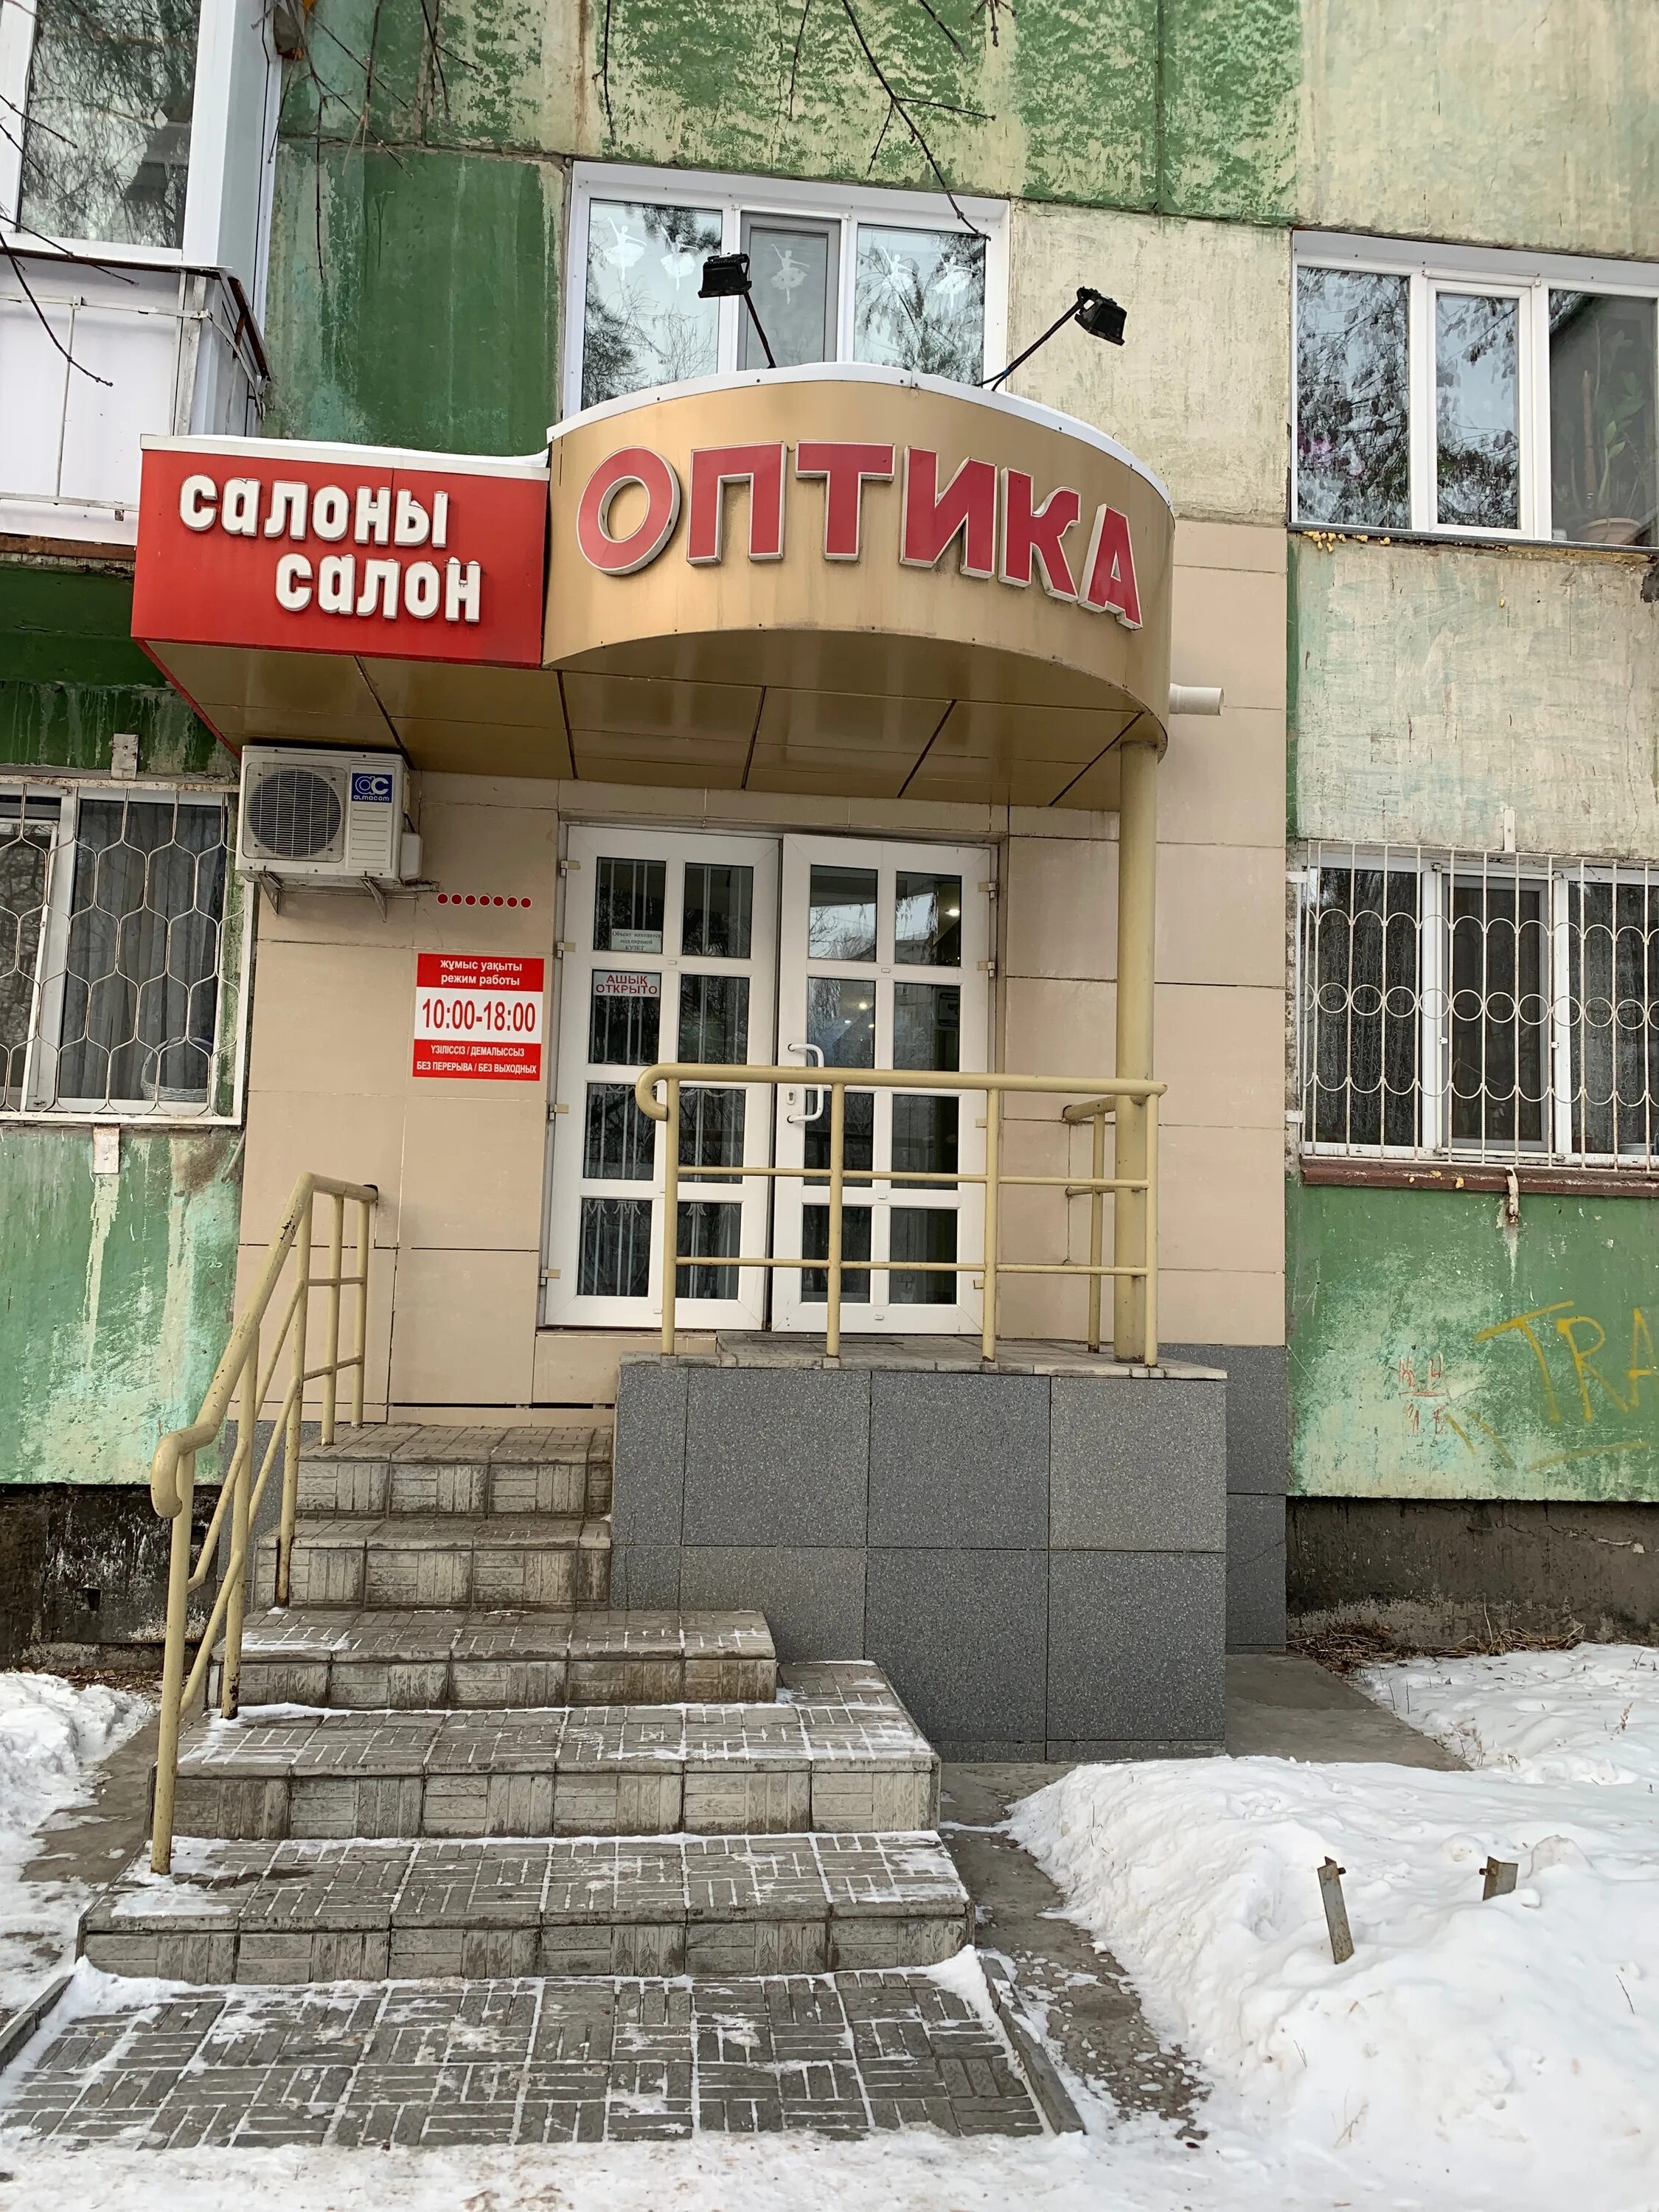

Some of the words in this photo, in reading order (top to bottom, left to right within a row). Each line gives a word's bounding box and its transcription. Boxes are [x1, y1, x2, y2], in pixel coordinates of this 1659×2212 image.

[179, 474, 449, 549] салоны
[576, 440, 1144, 630] ОПТИКА
[275, 552, 481, 623] салон
[440, 960, 479, 971] жұмыс
[481, 961, 522, 972] уақыты
[441, 974, 476, 985] режим
[479, 975, 520, 987] работы
[596, 984, 657, 995] ОТКРЫТО
[422, 998, 536, 1032] 10:00-18:00
[470, 1047, 525, 1057] ДЕМАЛЫССЫЗ
[417, 1061, 431, 1071] БЕЗ
[433, 1062, 473, 1072] ПЕРЕРЫВА
[479, 1063, 493, 1073] БЕЗ
[494, 1064, 537, 1074] ВЫХОДНЫХ
